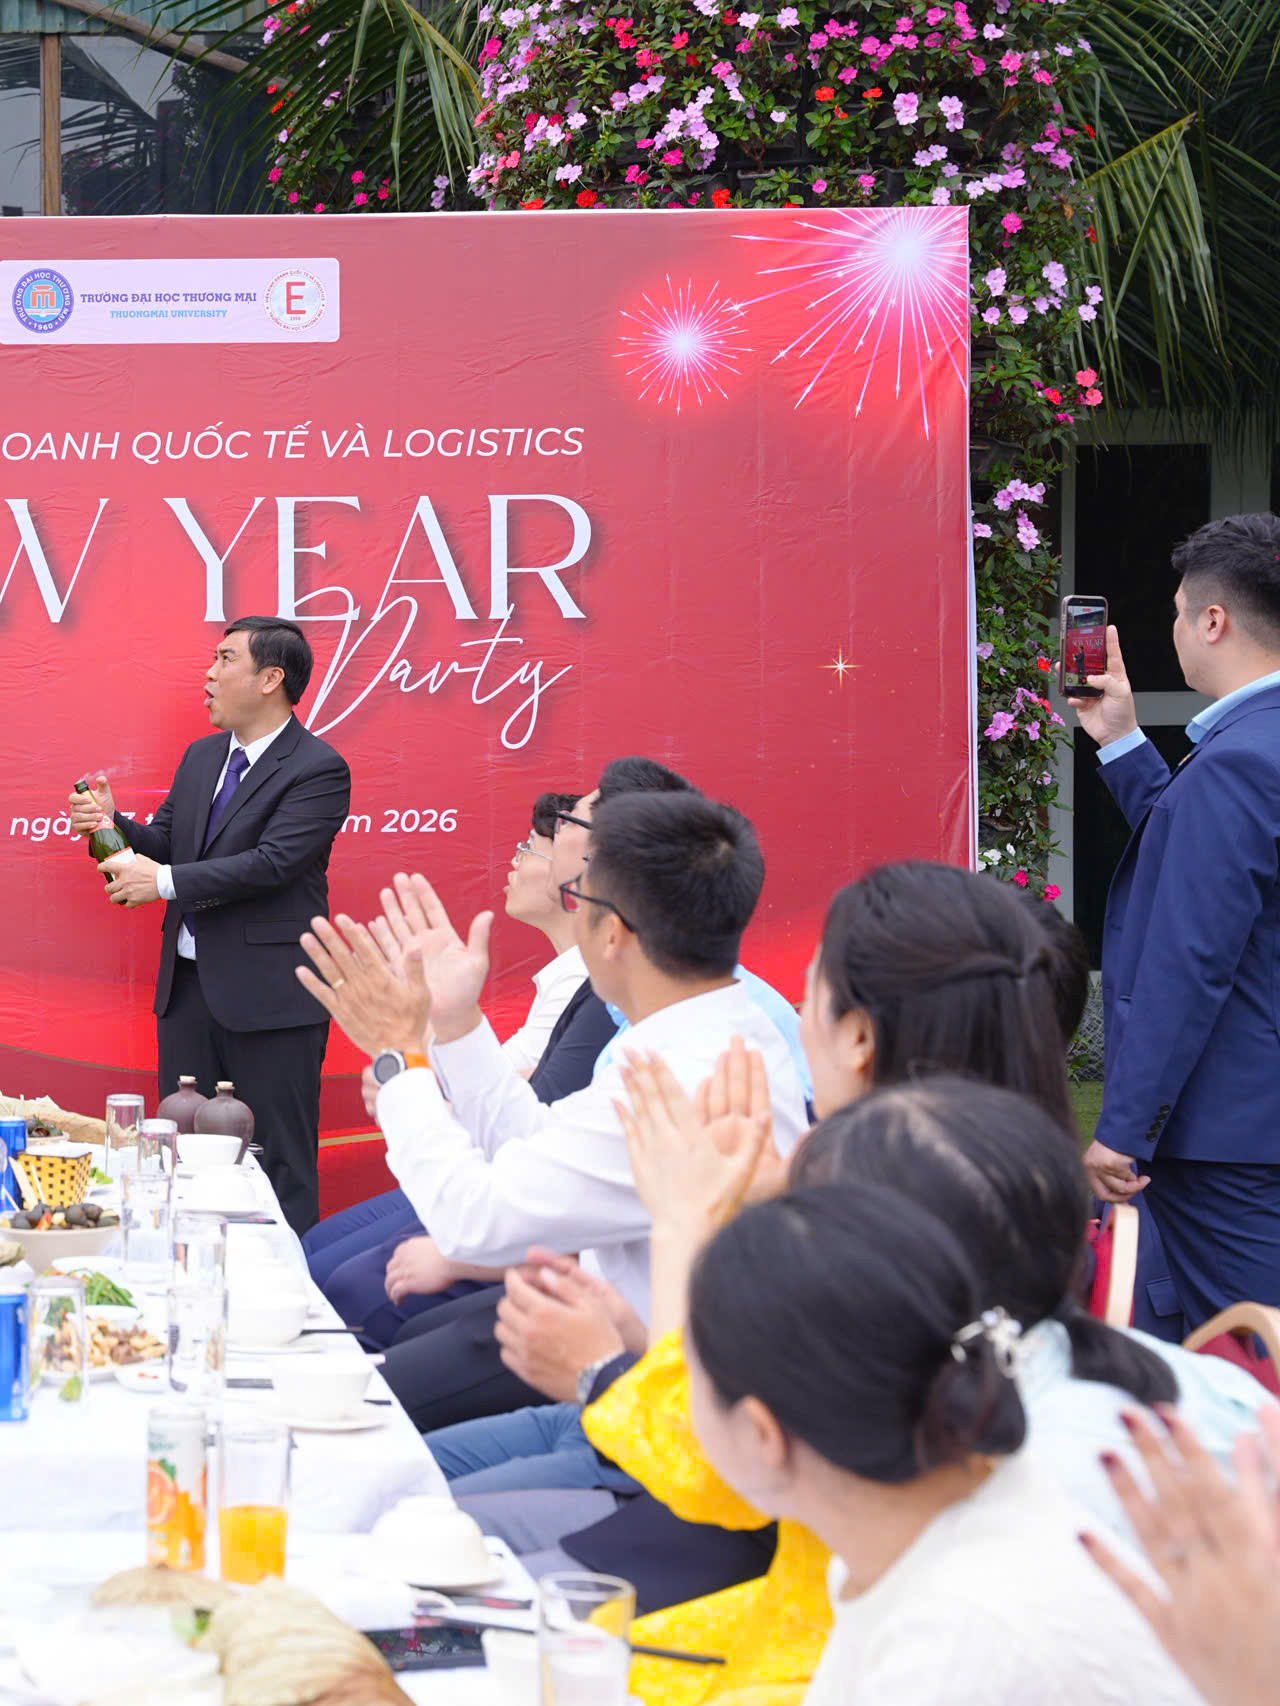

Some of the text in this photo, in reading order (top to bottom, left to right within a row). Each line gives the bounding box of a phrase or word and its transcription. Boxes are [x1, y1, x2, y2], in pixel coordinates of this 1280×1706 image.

[80, 292, 257, 304] TRƯỜNG ĐẠI HỌC THƯƠNG MẠI
[286, 282, 306, 314] E
[33, 322, 54, 331] 1960
[110, 309, 228, 319] THUONGMAI UNIVERSITY
[131, 421, 251, 465] QUỐC
[263, 420, 313, 459] TẾ
[320, 422, 370, 458] VÀ
[383, 427, 585, 458] LOGISTICS
[163, 494, 592, 623] YEAR
[293, 586, 573, 750] Party
[381, 808, 459, 833] 2026
